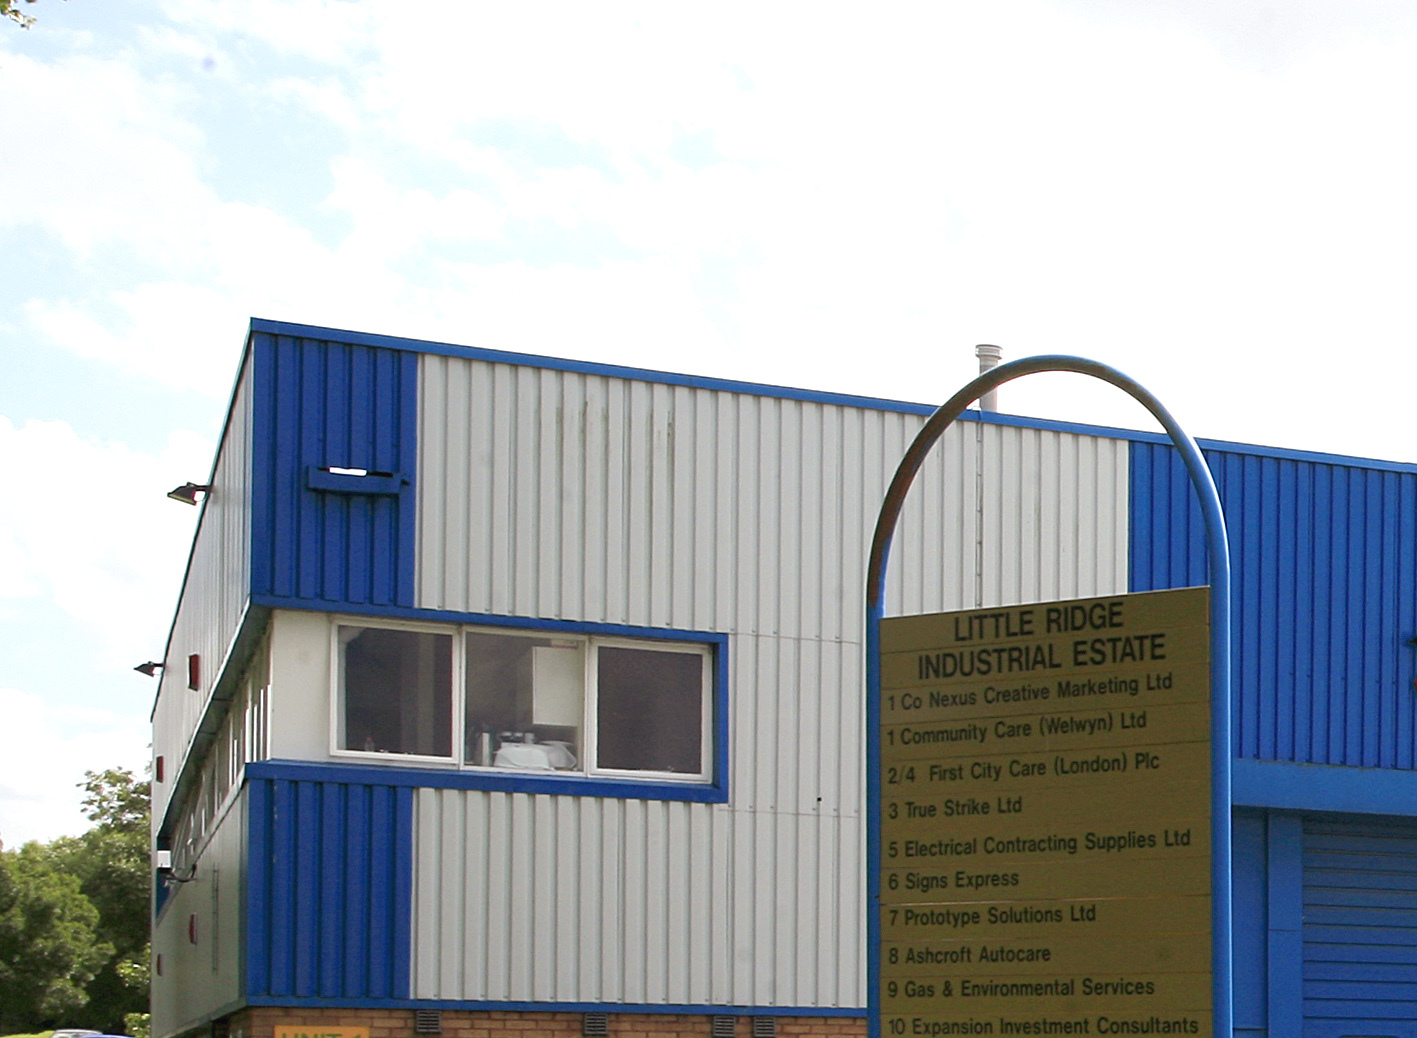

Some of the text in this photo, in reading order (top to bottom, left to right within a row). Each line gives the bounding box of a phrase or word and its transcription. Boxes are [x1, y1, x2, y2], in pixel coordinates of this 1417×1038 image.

[954, 602, 1124, 641] LITTLE RIDGE
[919, 634, 1166, 679] INDUSTRIAL ESTATE
[888, 672, 1173, 712] 1 Co Nexus Creative Marketing Ltd
[887, 711, 1147, 746] 1 Community Care (Welwyn) Ltd
[930, 765, 963, 781] First
[971, 762, 1001, 783] City
[1009, 760, 1046, 777] Care
[1054, 752, 1127, 776] (London)
[1136, 752, 1159, 770] Plc
[889, 797, 1022, 819] 3 True Strike Ltd
[889, 829, 1190, 858] 5 Electrical Contracting Supplies Ltd
[889, 872, 1019, 892] 6 Signs Express
[890, 905, 1096, 928] 7 Prototype Solutions Ltd
[889, 945, 1050, 964] 8 Ashcroft Autocare
[888, 977, 1155, 998] 9 Gas & Environmental Services
[889, 1016, 1199, 1037] 10 Expansion Investment Consultants
